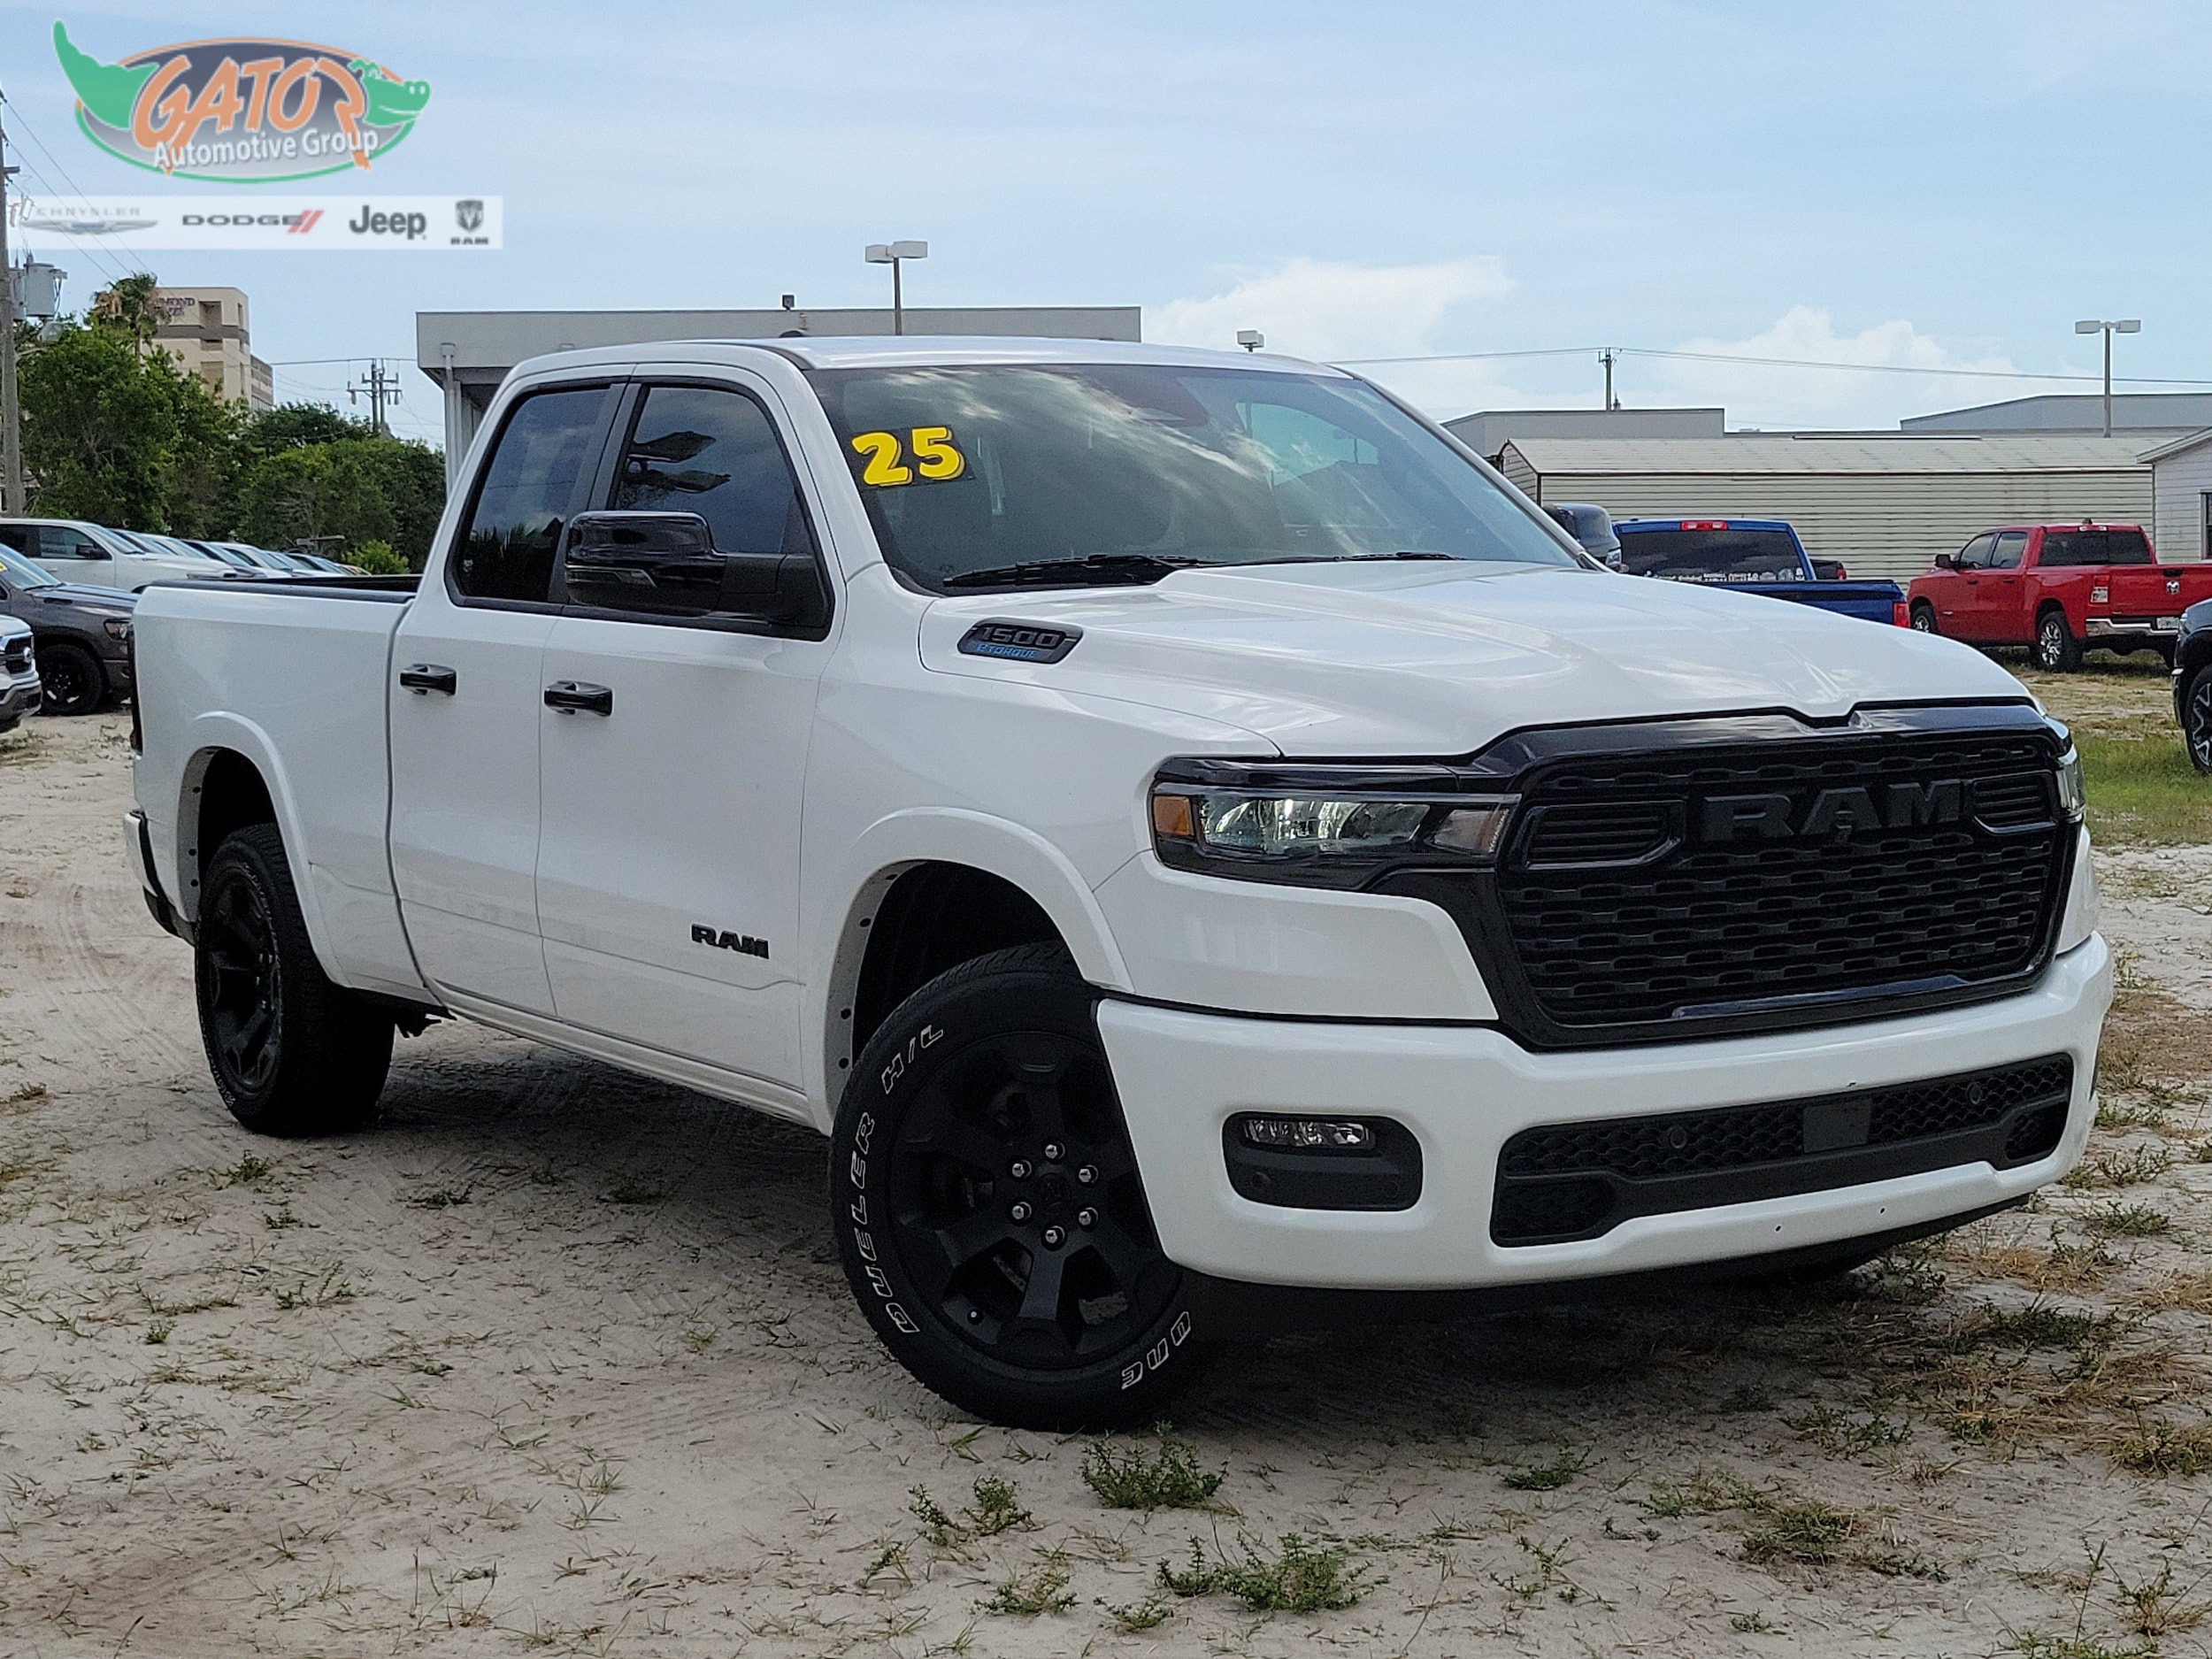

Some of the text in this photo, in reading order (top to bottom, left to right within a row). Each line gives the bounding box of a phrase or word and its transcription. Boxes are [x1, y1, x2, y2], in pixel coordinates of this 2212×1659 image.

[851, 426, 965, 487] 25
[982, 626, 1060, 647] 1500
[1704, 779, 1961, 843] RAM
[691, 923, 770, 960] RAM
[850, 1112, 919, 1333] DUELER
